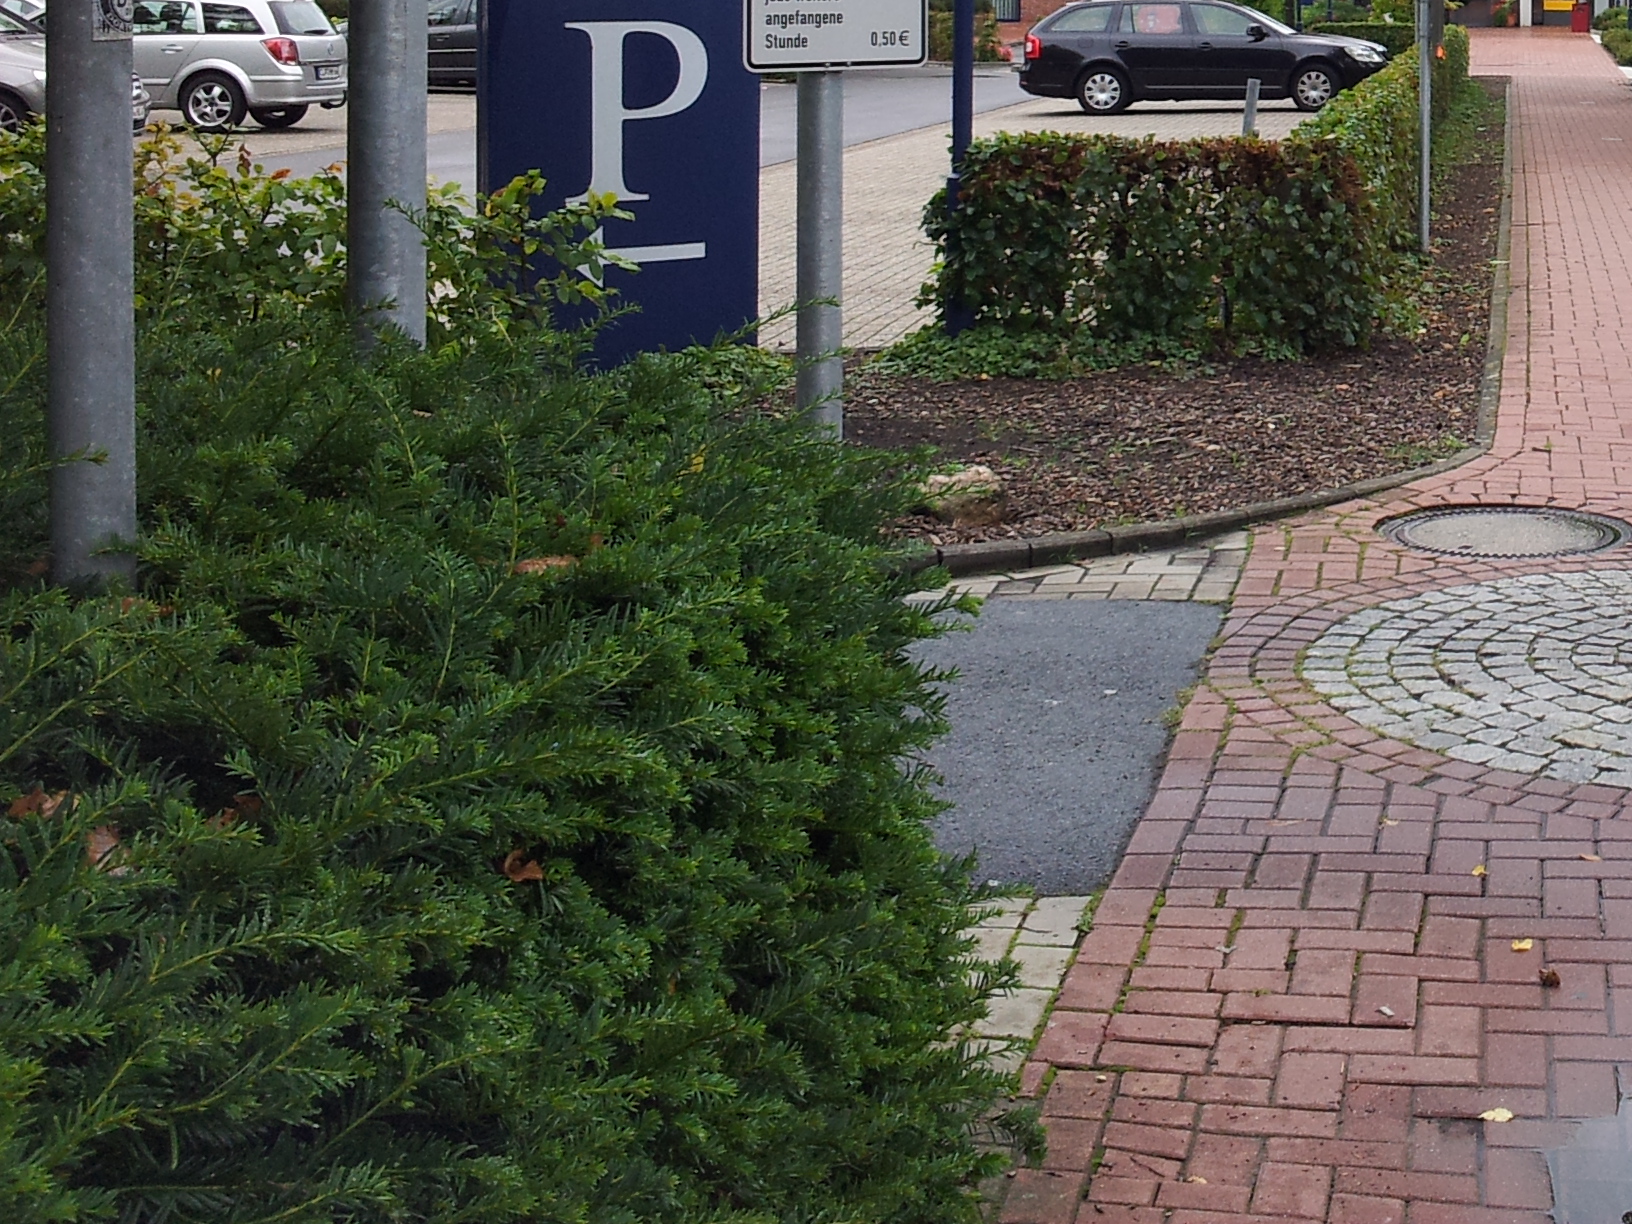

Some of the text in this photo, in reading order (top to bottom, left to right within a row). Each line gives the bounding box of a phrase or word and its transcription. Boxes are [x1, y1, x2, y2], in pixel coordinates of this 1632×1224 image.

[765, 9, 844, 29] angefangene
[764, 33, 809, 49] Stunde
[564, 20, 708, 203] P
